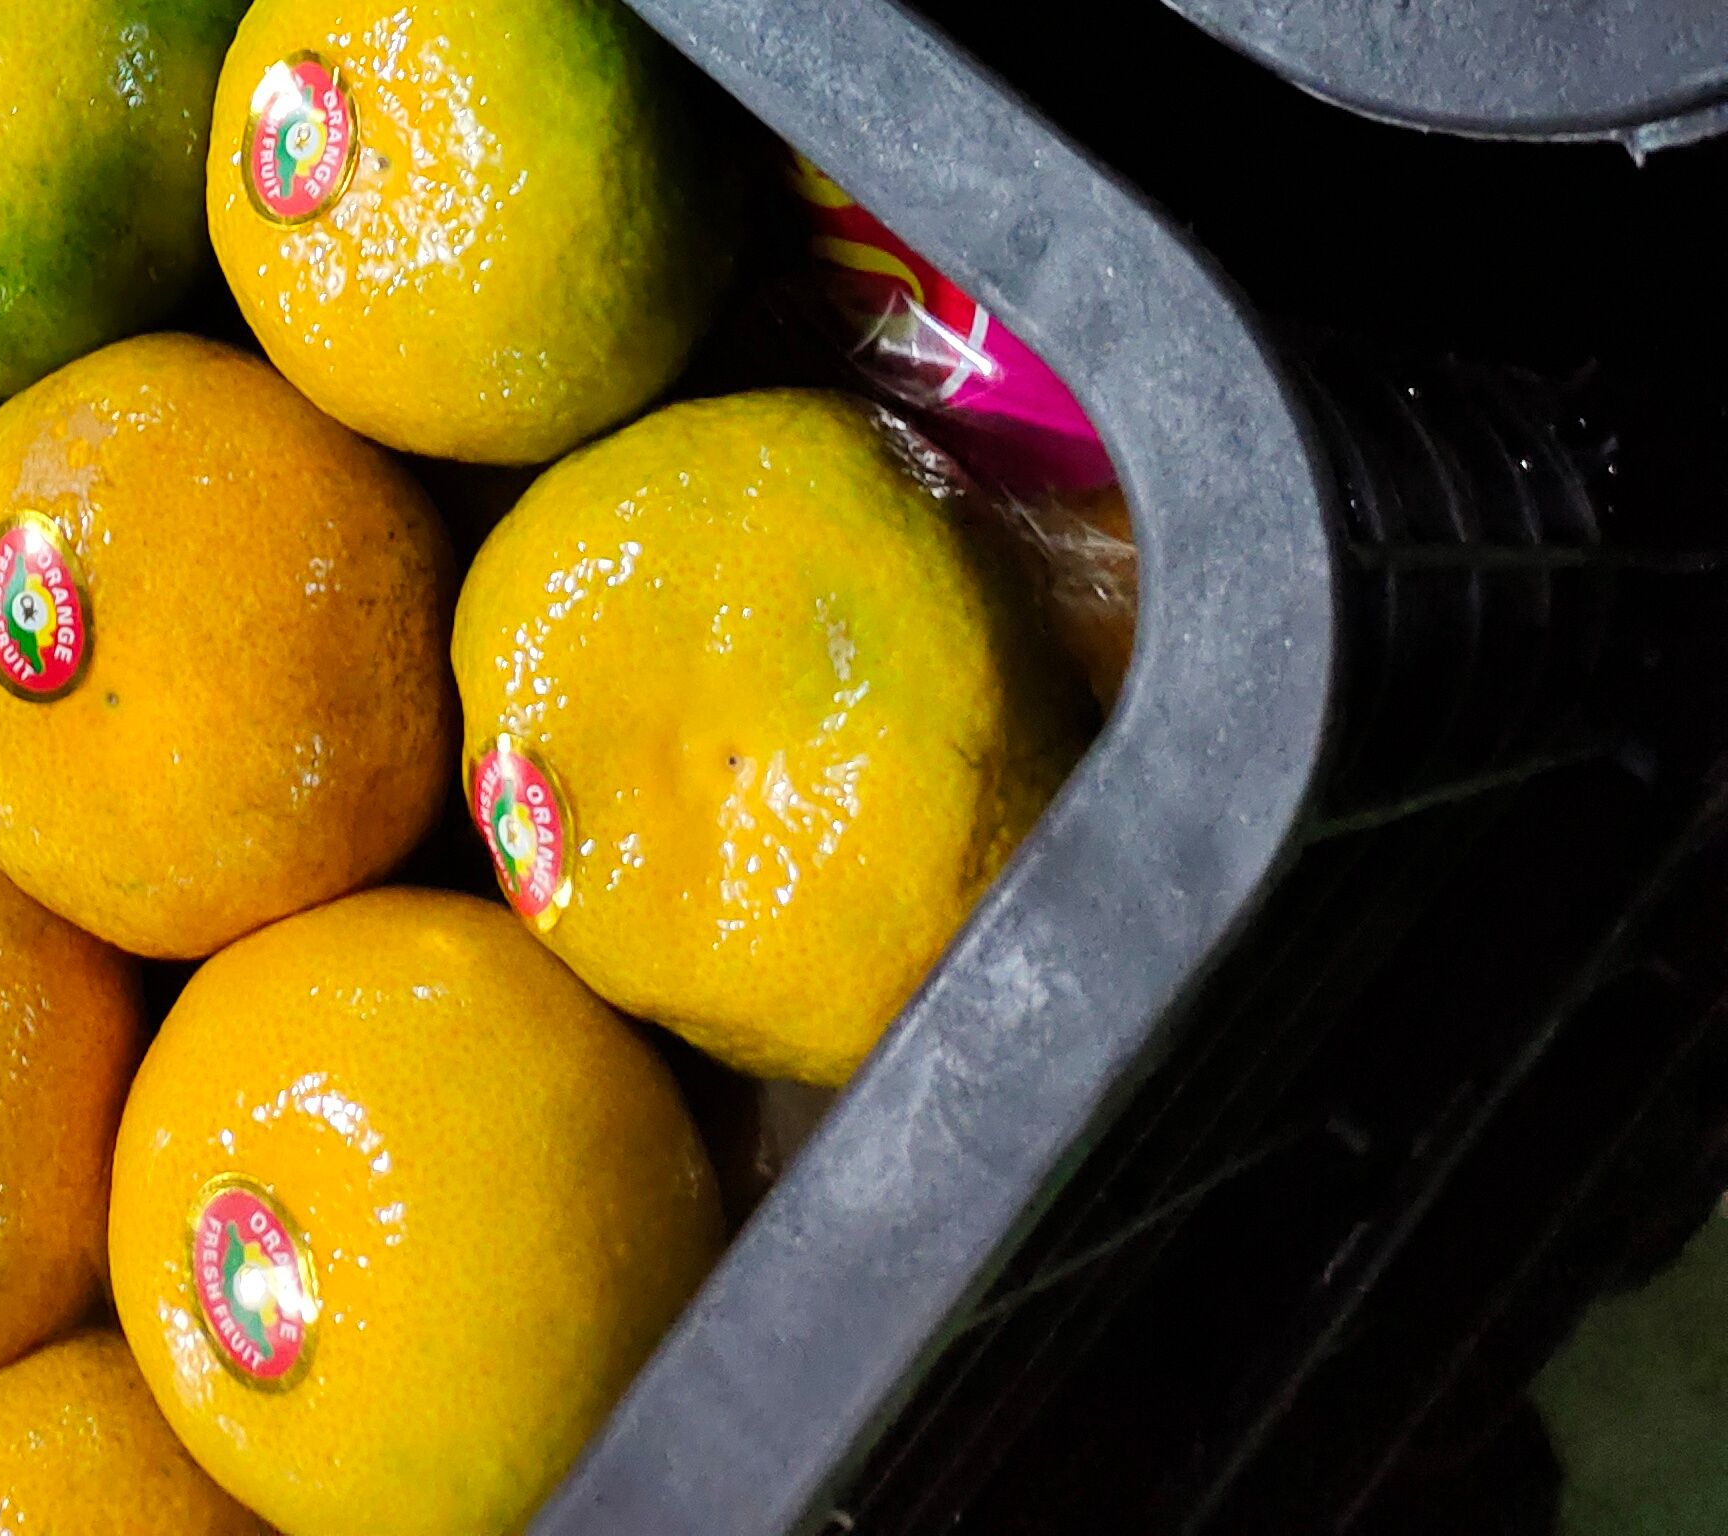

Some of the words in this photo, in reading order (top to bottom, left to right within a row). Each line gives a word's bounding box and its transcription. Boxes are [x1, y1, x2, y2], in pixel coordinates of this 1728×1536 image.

[258, 137, 283, 200] FRUIT
[302, 90, 344, 199] ORANGE
[36, 551, 78, 666] ORANGE
[524, 783, 555, 905] ORANGE
[202, 1216, 224, 1298] FRESH
[213, 1304, 263, 1371] FRUIT
